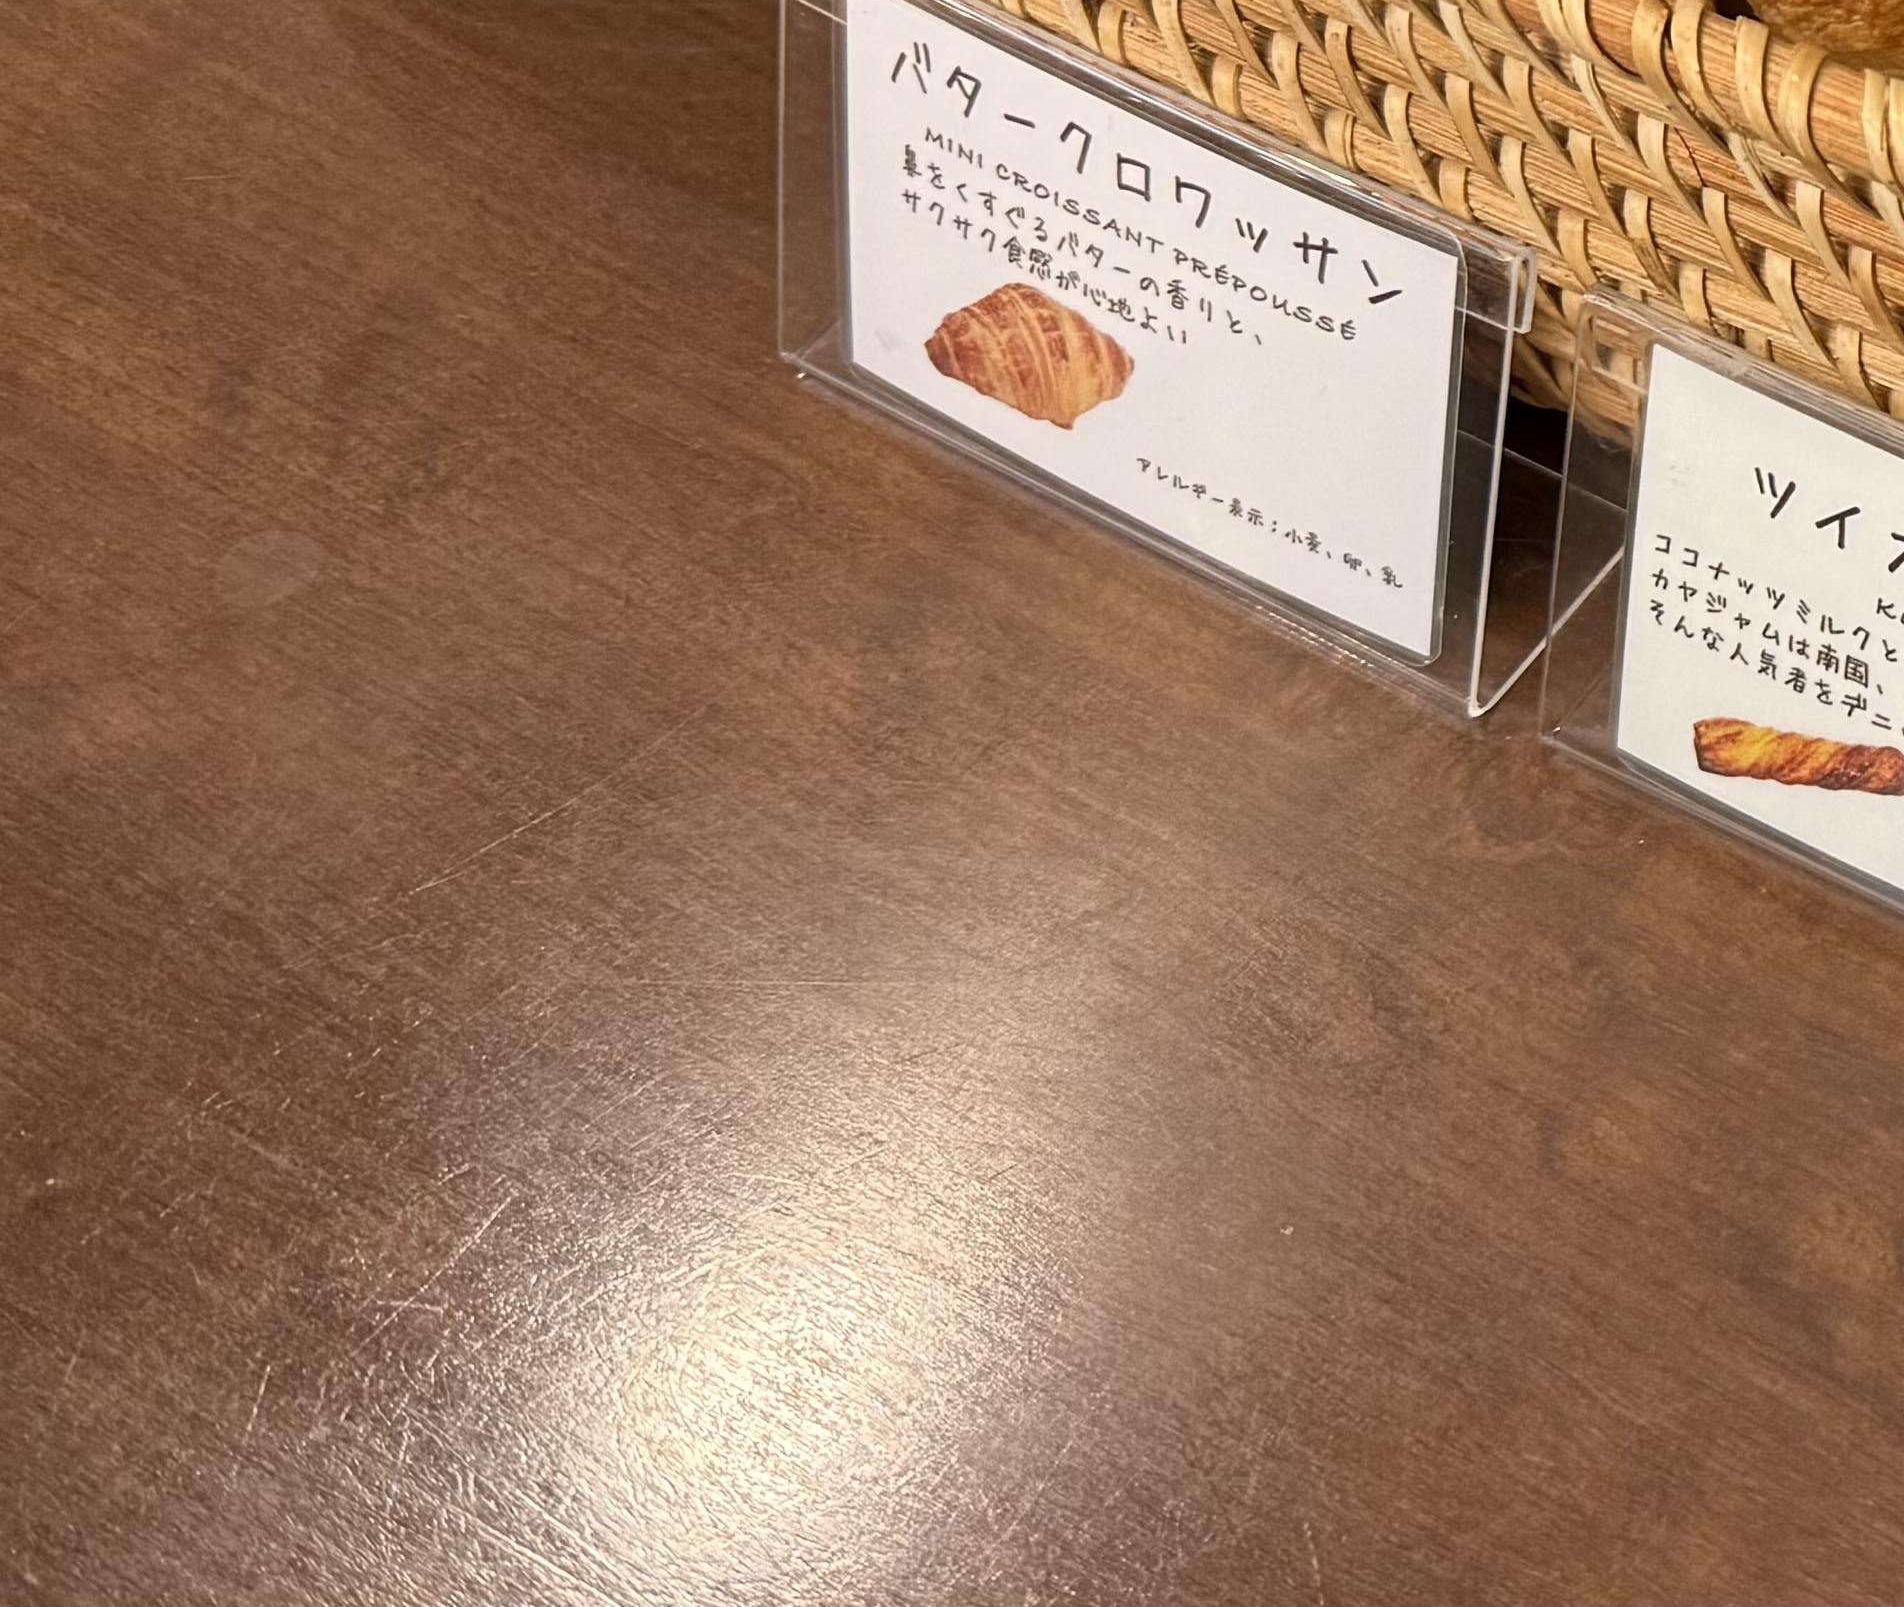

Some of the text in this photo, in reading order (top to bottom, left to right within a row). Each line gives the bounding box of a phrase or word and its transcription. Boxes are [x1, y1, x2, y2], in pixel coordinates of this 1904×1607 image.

[891, 41, 1402, 304] バタークロワッサン
[925, 127, 982, 168] MINI
[995, 163, 1164, 254] CROISSANT
[902, 188, 1187, 344] サクサク食感が心地よい
